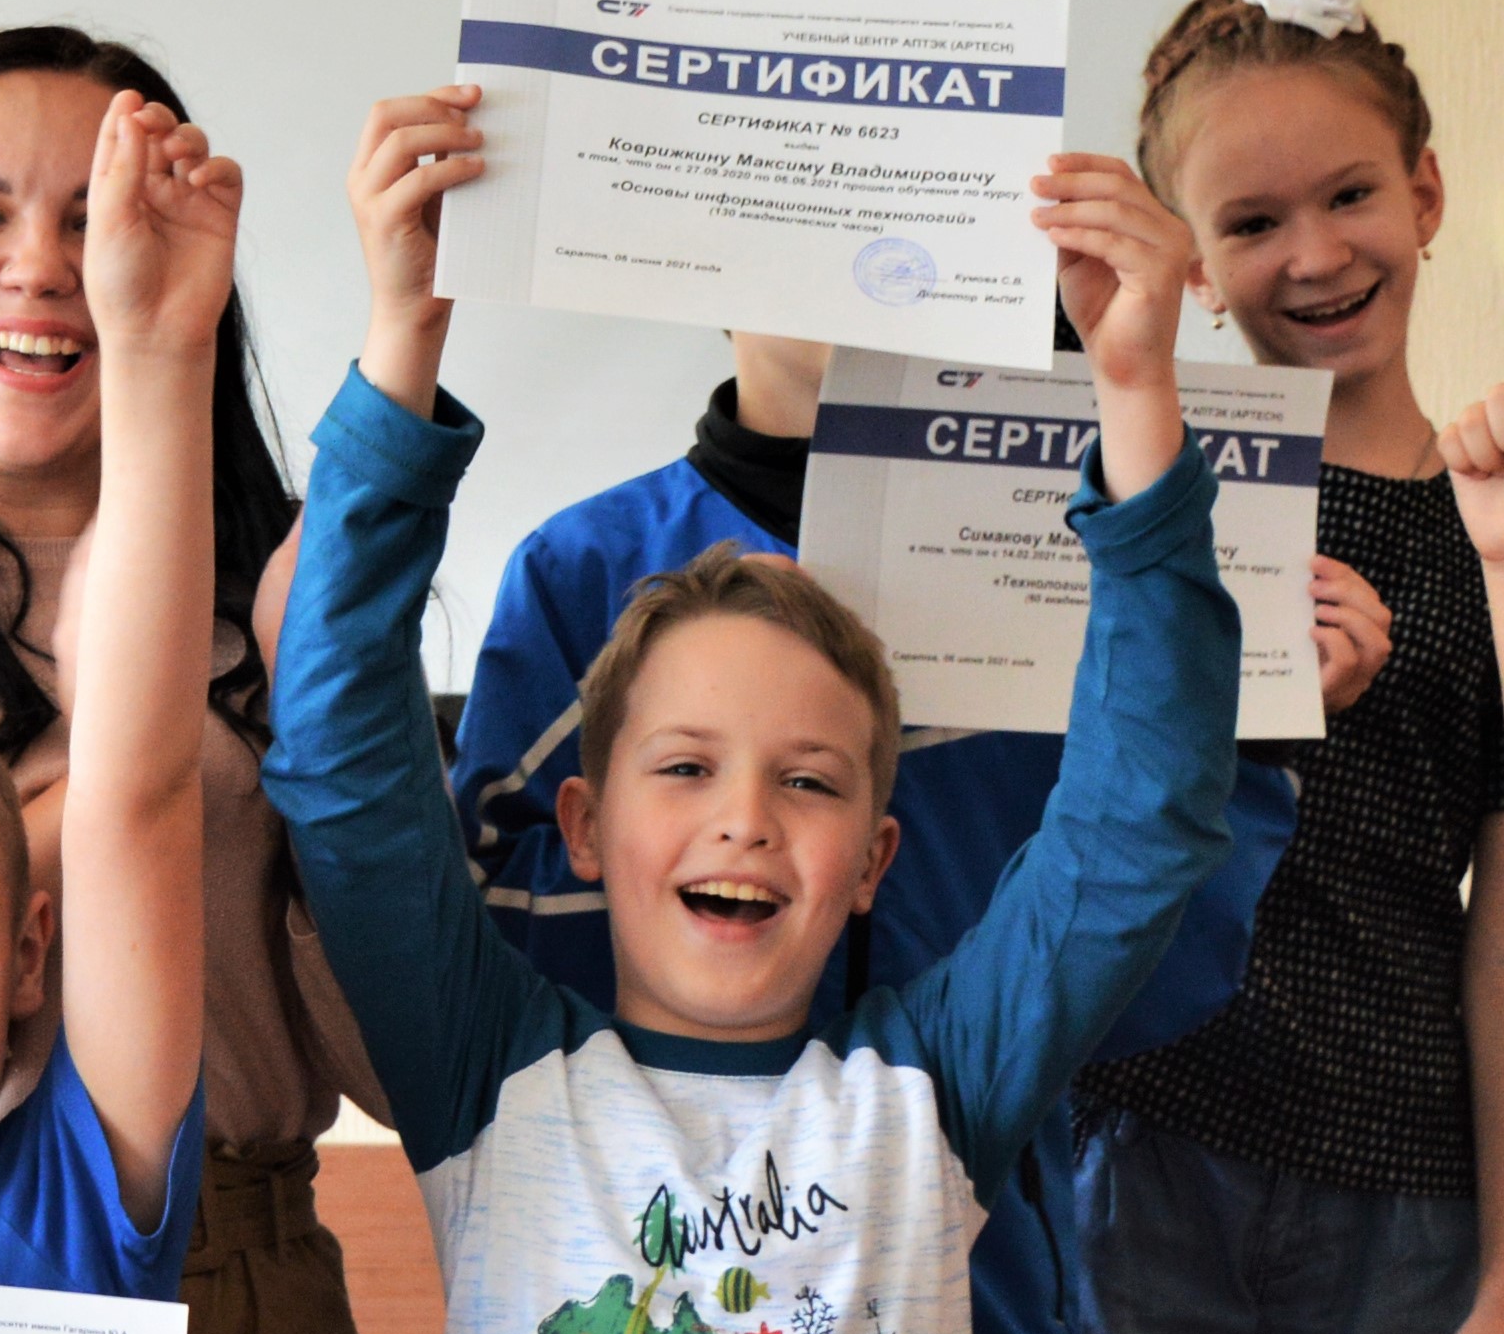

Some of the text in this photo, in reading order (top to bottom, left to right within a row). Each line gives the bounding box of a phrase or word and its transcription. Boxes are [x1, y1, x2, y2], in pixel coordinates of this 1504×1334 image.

[591, 39, 1013, 108] СЕРТИФИКАТ
[698, 113, 826, 134] СЕРТИФИКАТ
[858, 126, 899, 139] 6623
[737, 153, 824, 176] Максиму
[830, 162, 995, 186] Владимировичу
[694, 192, 852, 216] информационных
